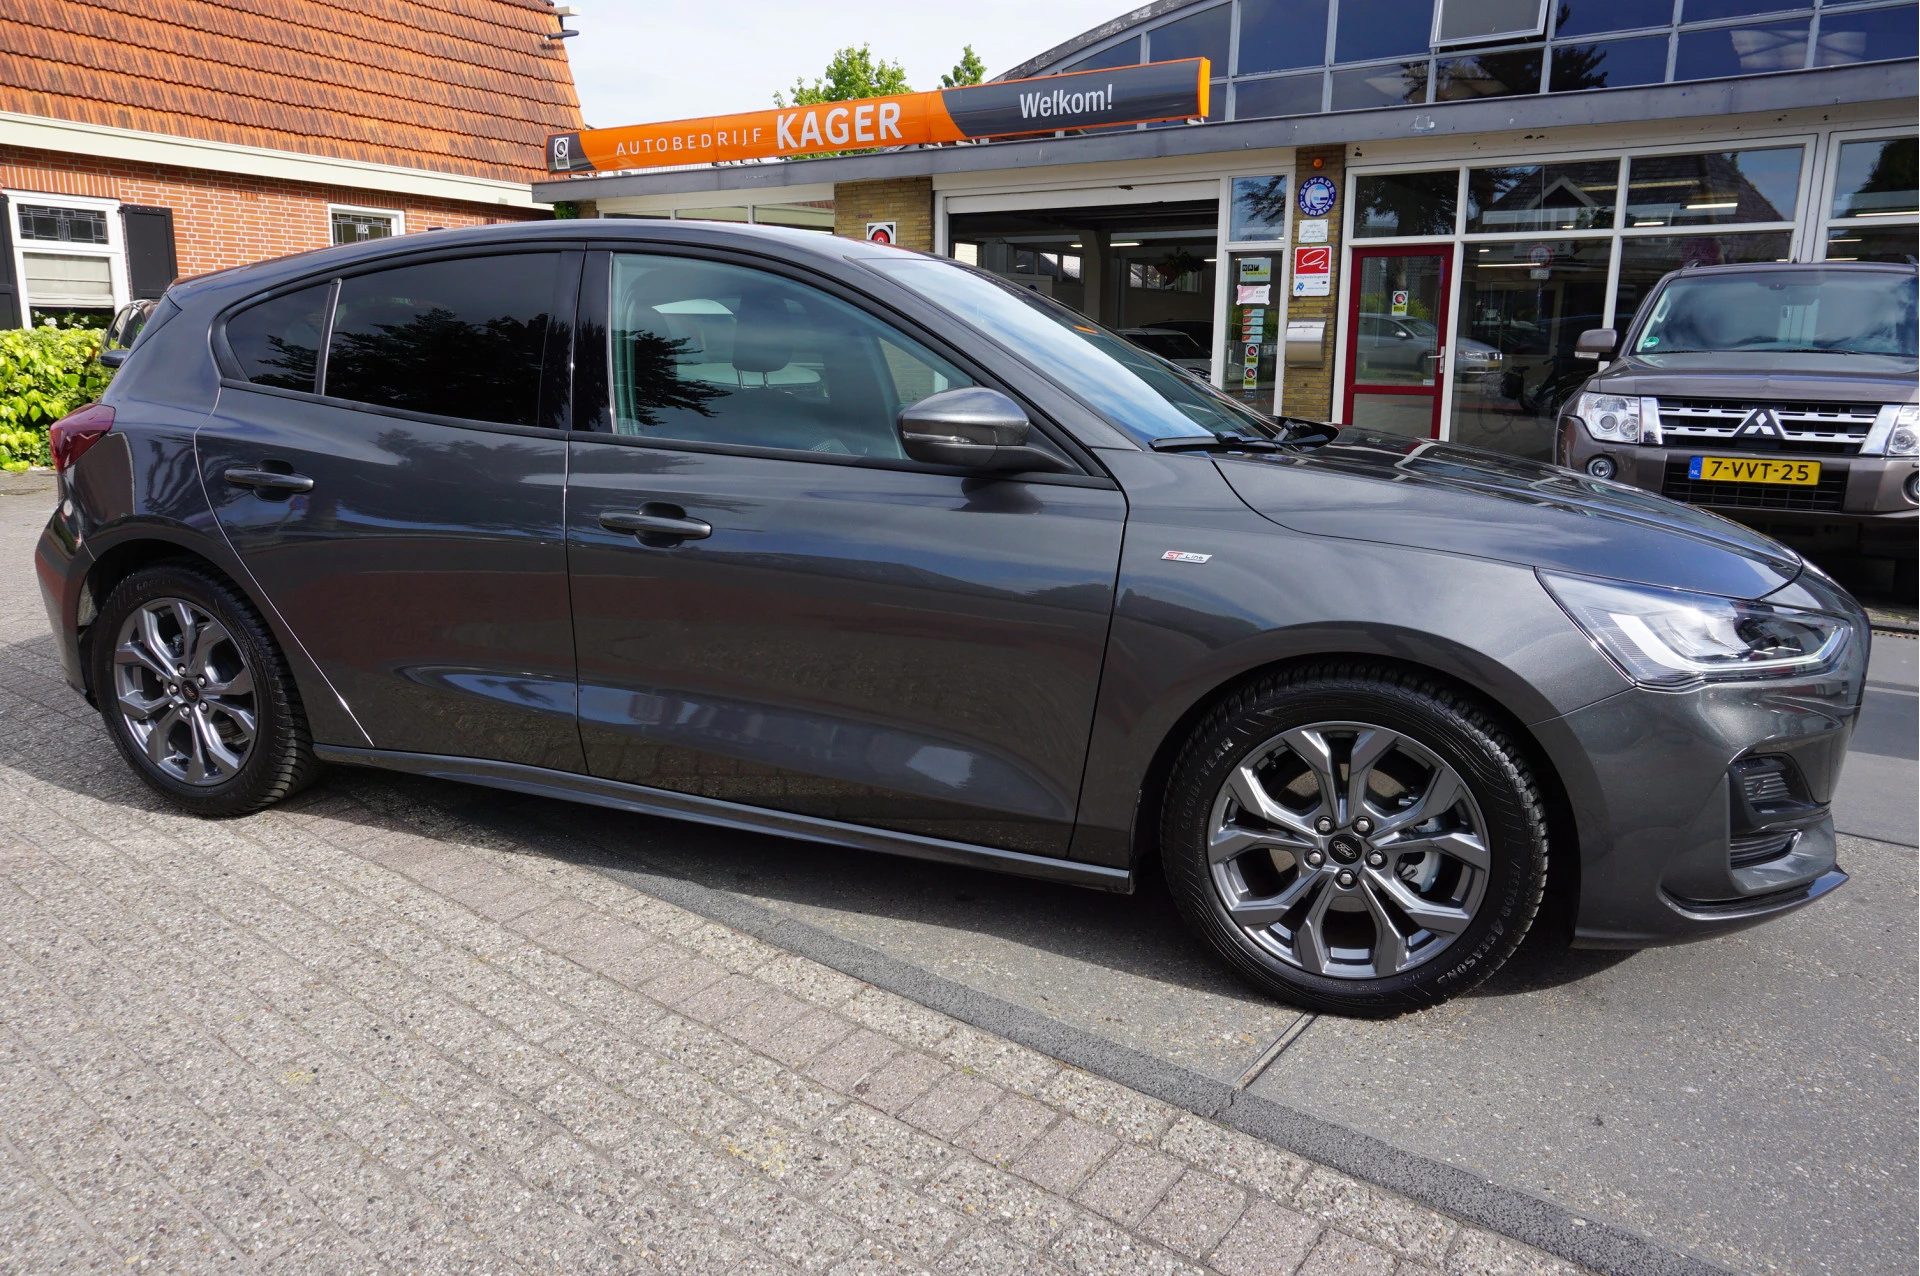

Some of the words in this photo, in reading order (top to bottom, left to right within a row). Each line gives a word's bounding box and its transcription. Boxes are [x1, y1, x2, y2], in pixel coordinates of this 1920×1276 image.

[1020, 84, 1113, 118] Welkom!
[616, 128, 762, 156] AUTOBEDRIJF
[777, 102, 902, 149] KAGER
[1300, 177, 1335, 196] SCHADE
[1300, 198, 1333, 216] GARANT
[1711, 461, 1809, 481] 7-VVT-25
